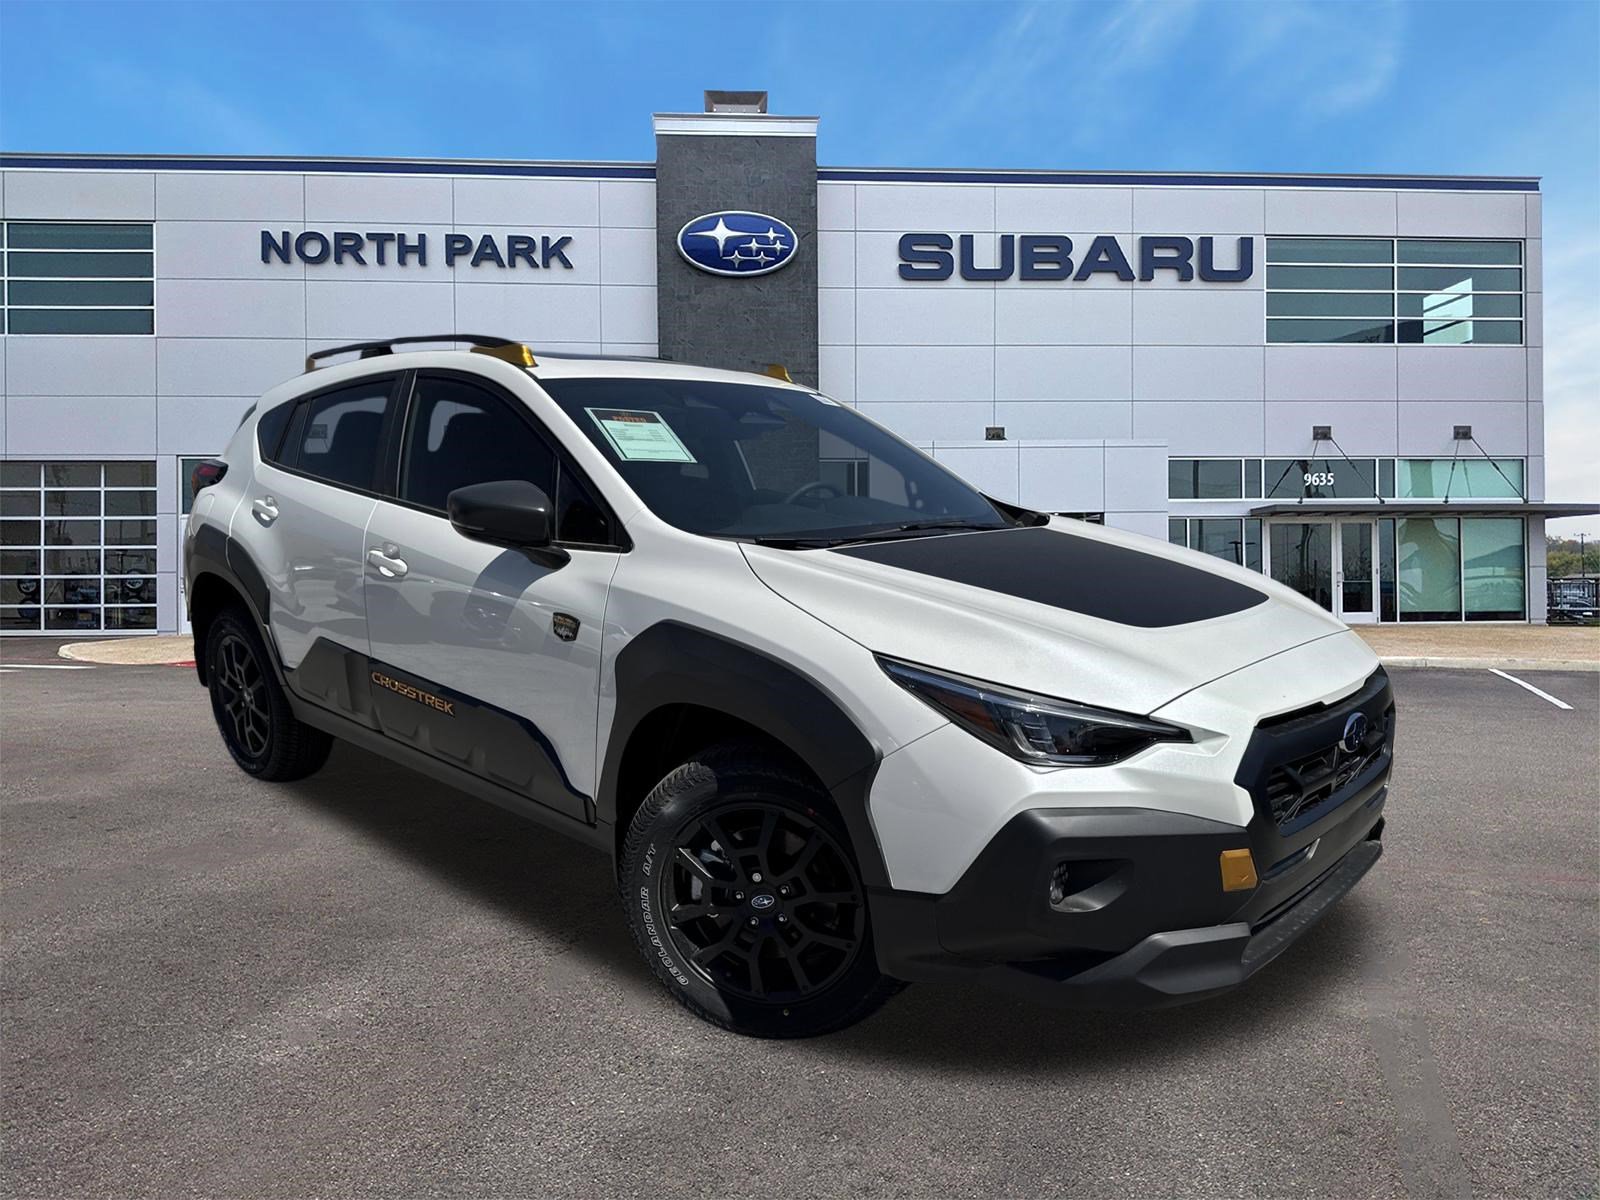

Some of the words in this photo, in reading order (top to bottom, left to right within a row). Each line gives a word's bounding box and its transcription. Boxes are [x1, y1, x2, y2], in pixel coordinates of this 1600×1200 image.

[260, 230, 428, 266] NORTH
[444, 233, 574, 269] PARK
[898, 232, 1254, 283] SUBARU
[1303, 472, 1335, 486] 9635
[371, 671, 455, 716] CROSSTREK
[642, 843, 657, 876] A/T
[640, 886, 689, 986] GEOLANDAR
